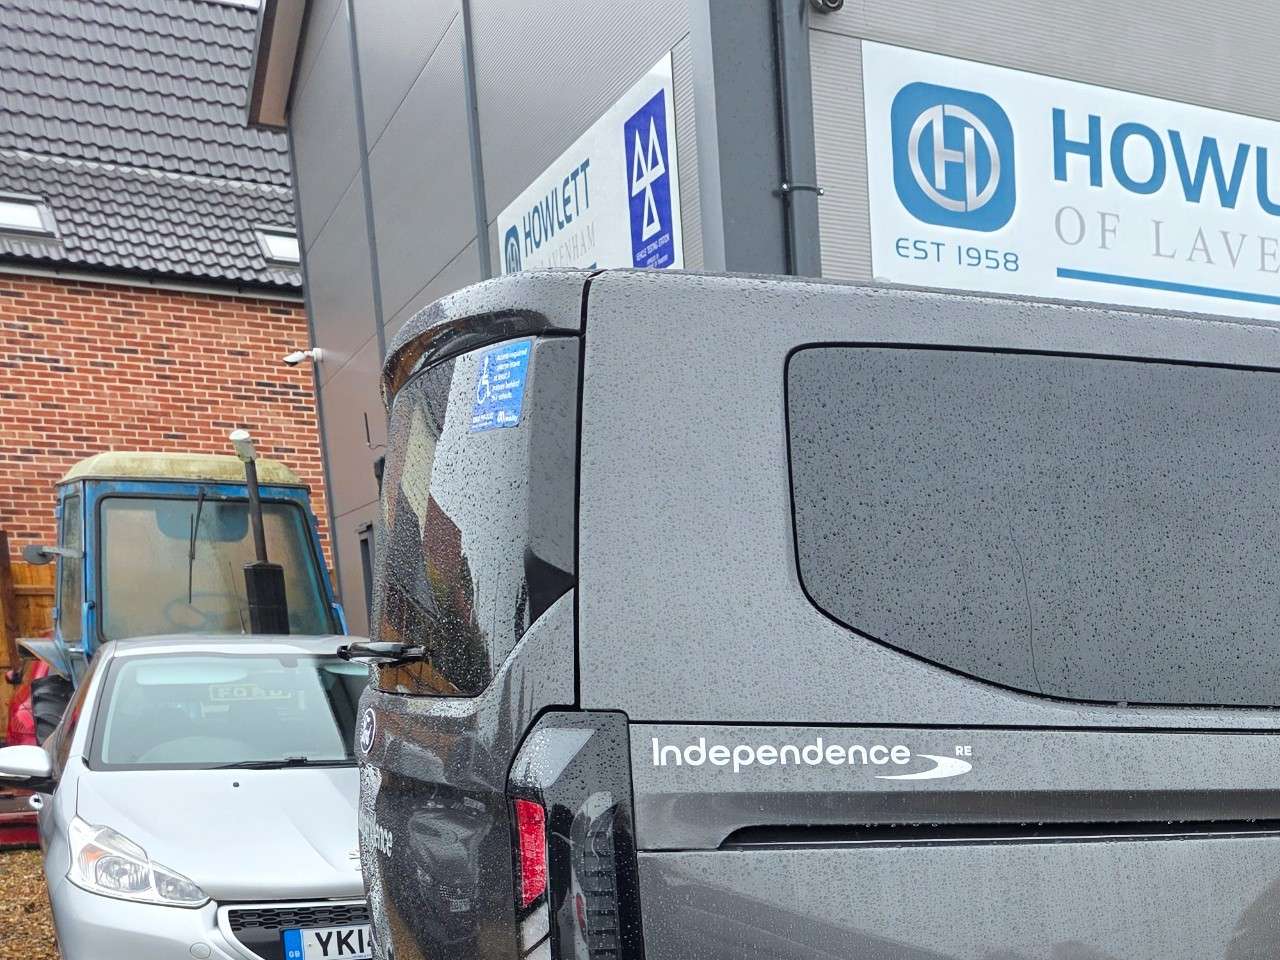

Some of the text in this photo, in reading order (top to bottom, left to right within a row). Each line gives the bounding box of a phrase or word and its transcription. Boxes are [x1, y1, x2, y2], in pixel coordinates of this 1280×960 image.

[523, 158, 590, 257] HOWLETT
[1054, 206, 1120, 250] OF
[895, 237, 1019, 272] EST 1958
[652, 737, 972, 773] Independence RE
[315, 928, 372, 957] YK1
